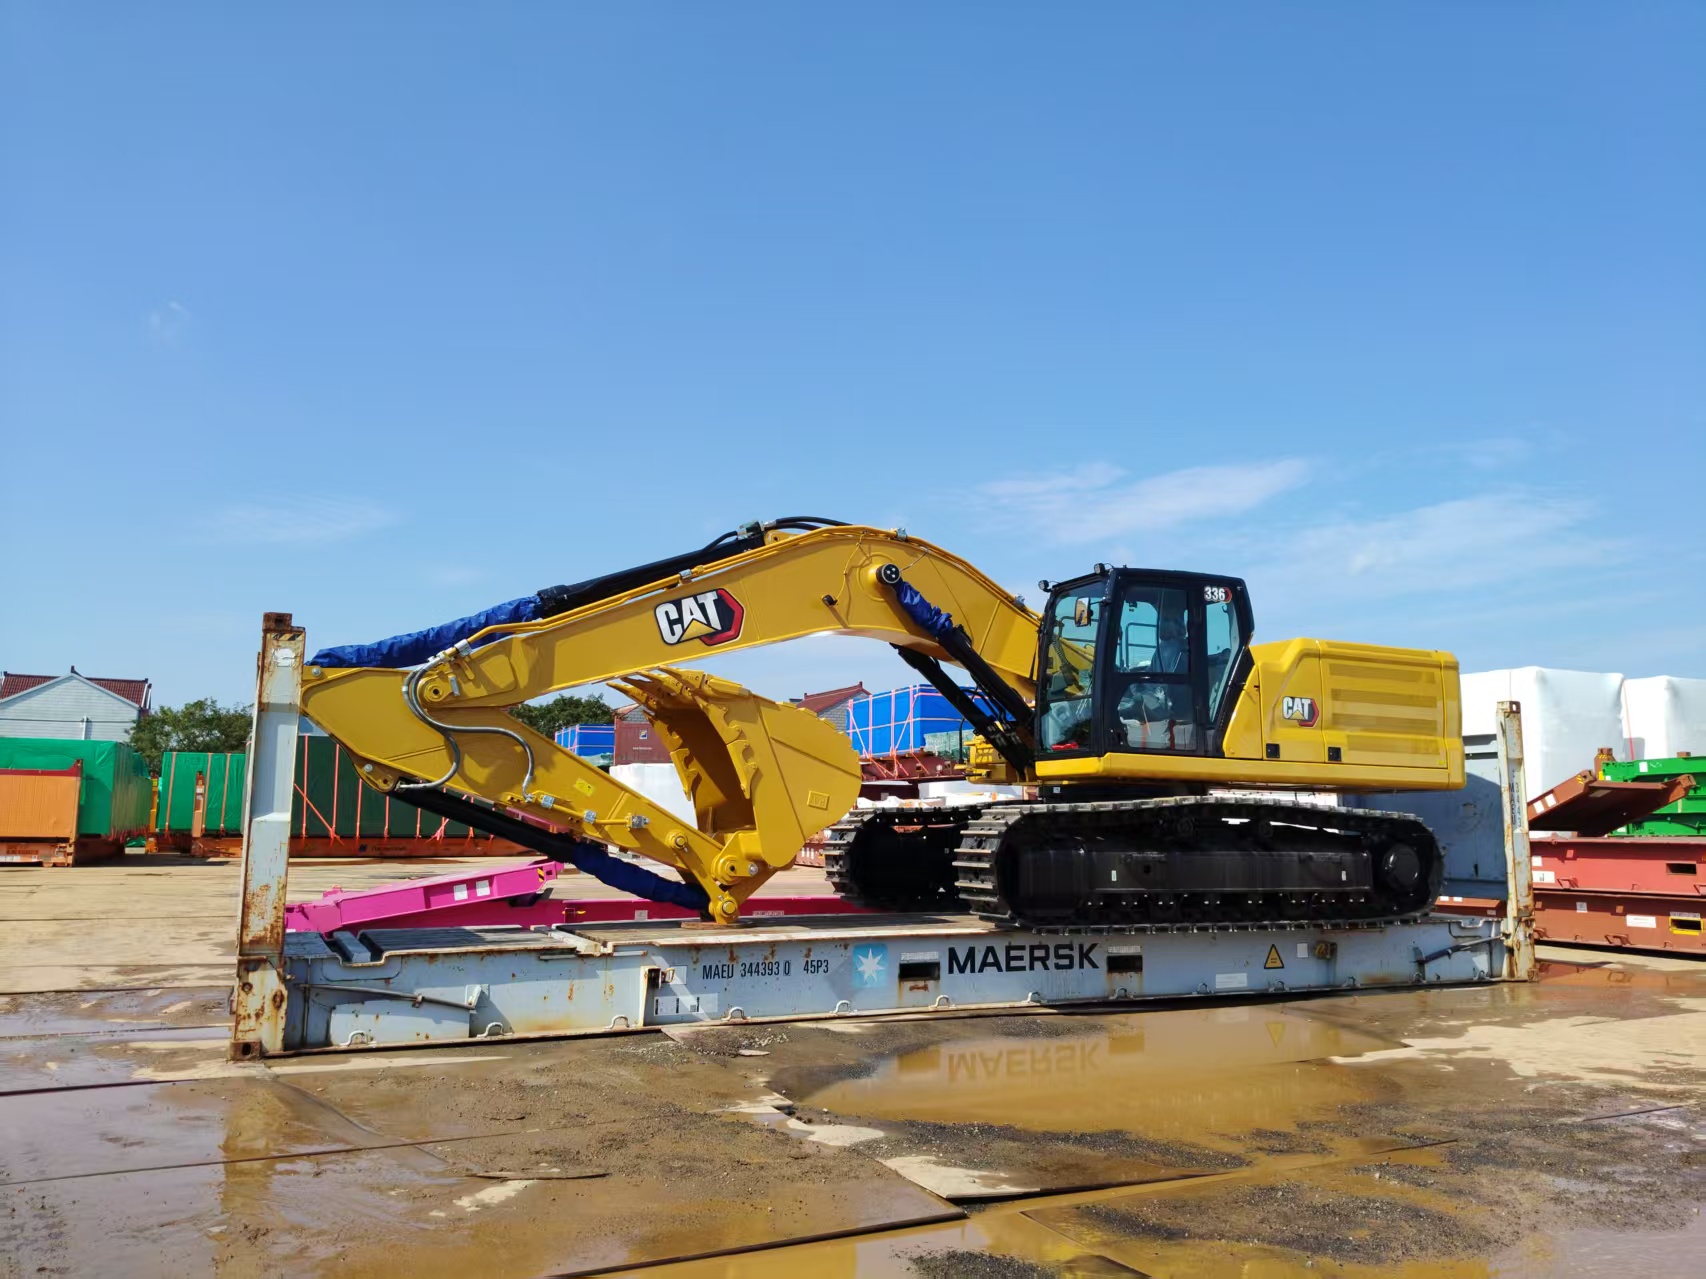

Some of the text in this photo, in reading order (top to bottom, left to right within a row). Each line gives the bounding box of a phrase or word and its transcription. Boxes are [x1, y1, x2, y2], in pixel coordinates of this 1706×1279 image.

[1204, 586, 1226, 601] 336
[655, 590, 722, 644] CAT
[1282, 696, 1312, 720] CAT
[702, 964, 734, 980] MAEU
[740, 961, 780, 977] 344393
[803, 959, 829, 974] 45P3
[947, 943, 1100, 974] MAERSK
